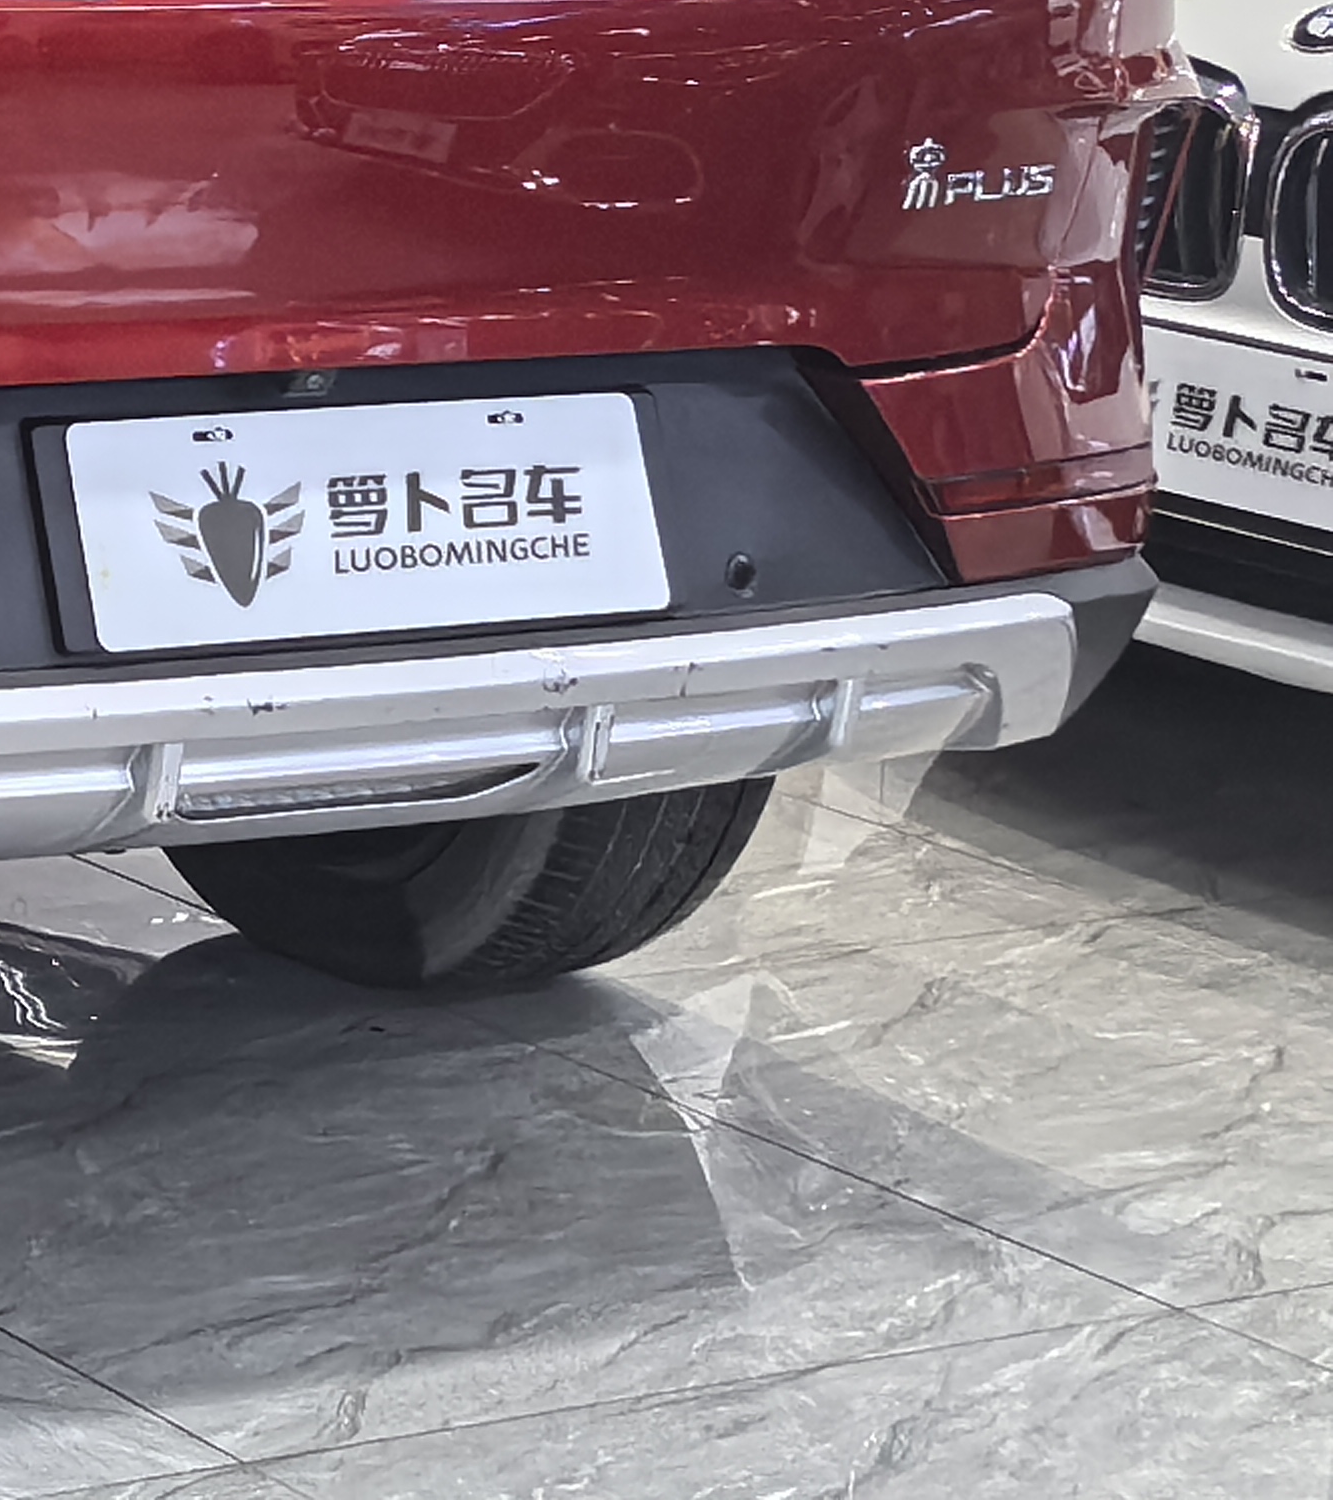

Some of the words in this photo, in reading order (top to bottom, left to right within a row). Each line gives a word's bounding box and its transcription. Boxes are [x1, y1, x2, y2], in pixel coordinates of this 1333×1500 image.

[944, 164, 1055, 206] PLUS
[327, 465, 583, 538] 萝卜名车
[334, 533, 590, 574] LUOBOMINGCHE
